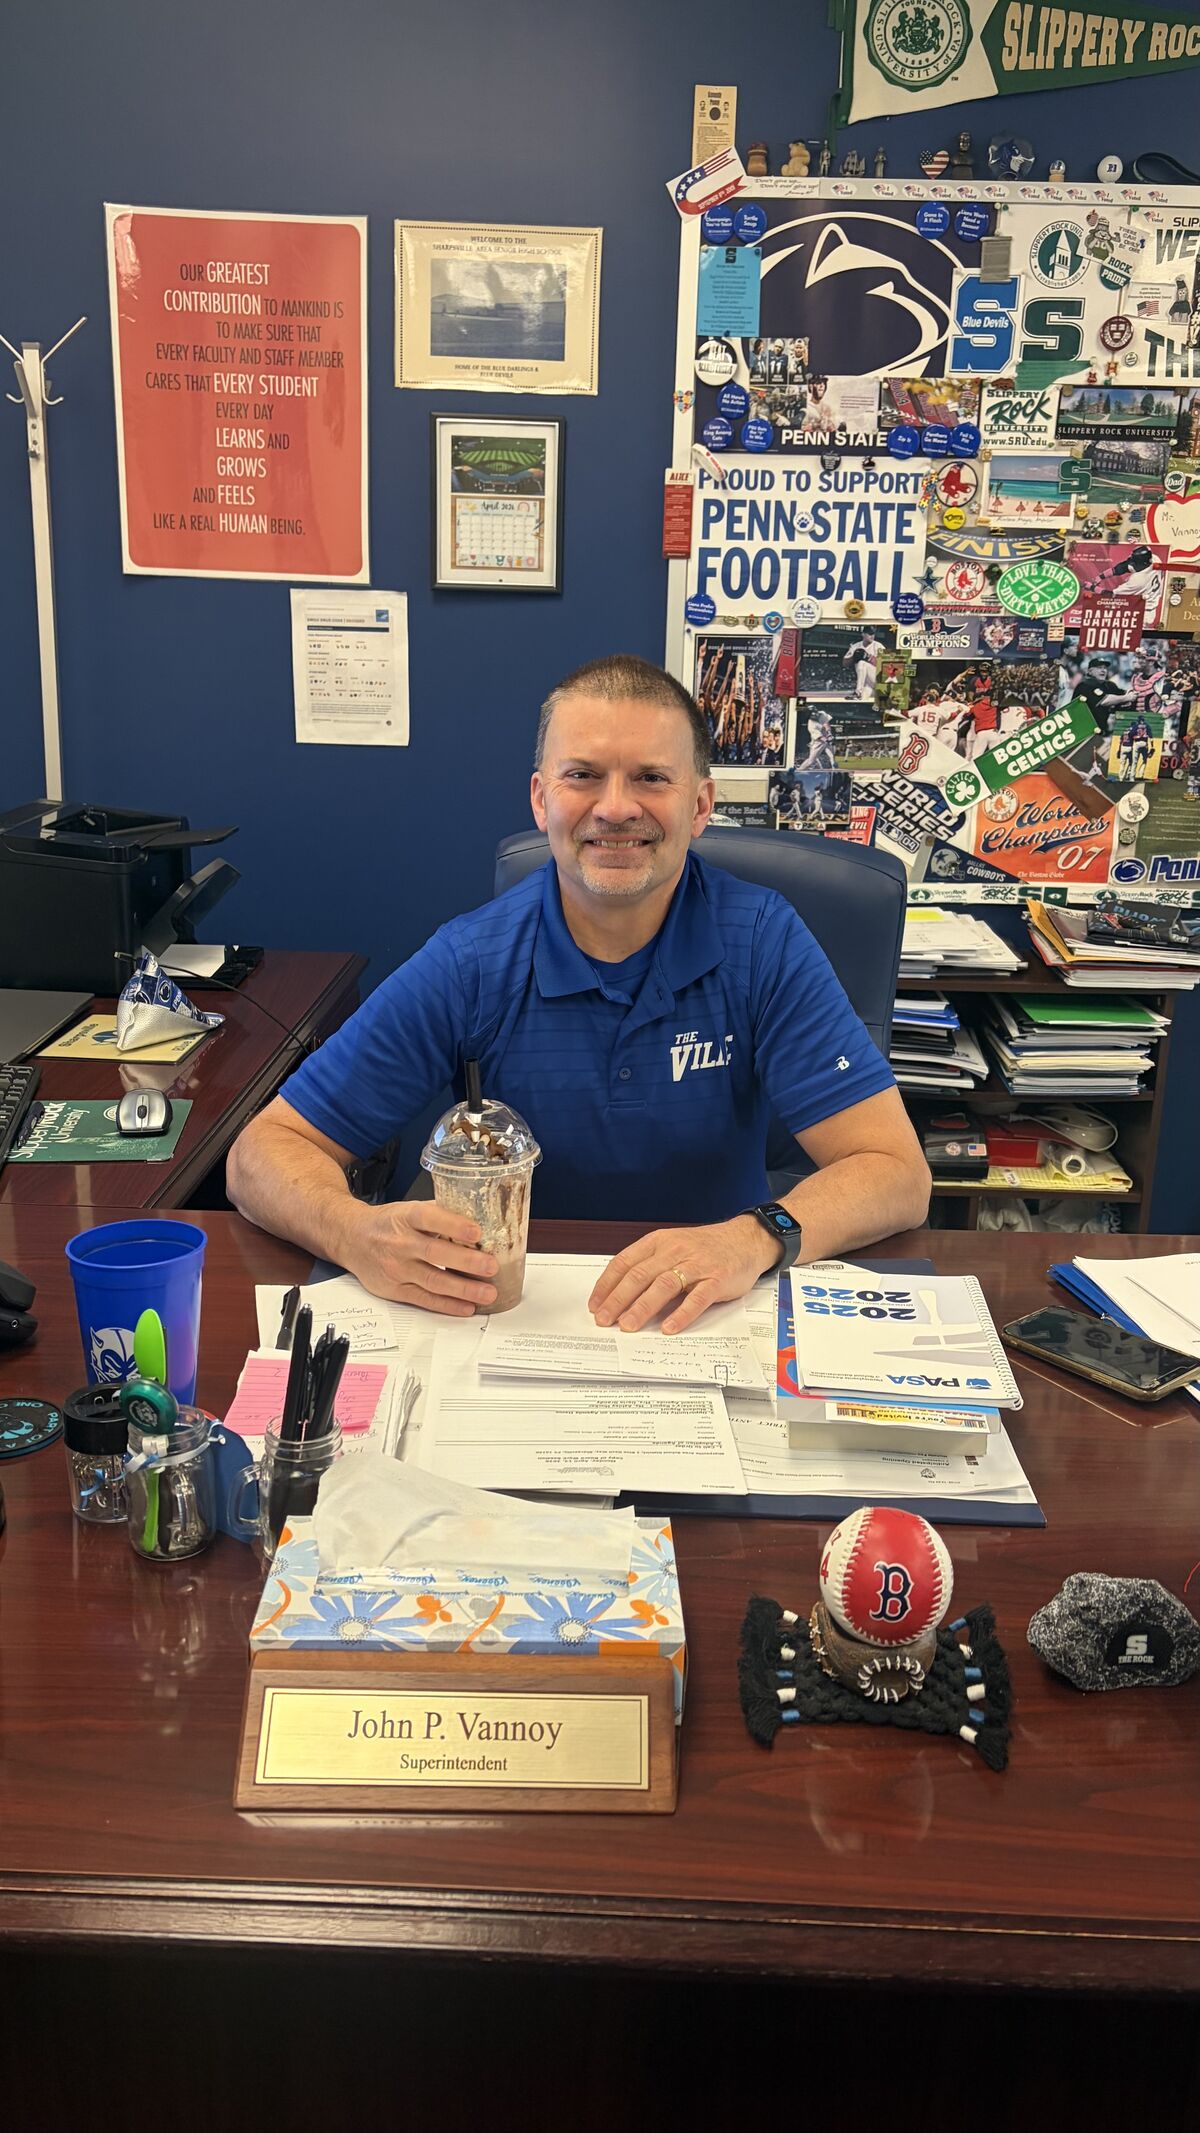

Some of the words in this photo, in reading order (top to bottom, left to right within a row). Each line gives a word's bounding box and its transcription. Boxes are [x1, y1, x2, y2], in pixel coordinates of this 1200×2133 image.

[1002, 2, 1146, 71] SLIPPERY
[875, 33, 940, 79] UNIVERSITY
[951, 39, 961, 54] PA
[1051, 222, 1069, 232] ROCK
[471, 236, 503, 244] WELCOME
[515, 237, 527, 245] THE
[180, 264, 204, 281] OUR
[206, 261, 270, 285] GREATEST
[1108, 256, 1133, 274] ROCK
[1101, 269, 1127, 287] PRIDE
[163, 289, 261, 315] CONTRIBUTION
[264, 298, 278, 315] TO
[281, 299, 330, 318] MANKIND
[333, 301, 344, 319] IS
[216, 321, 230, 339] TO
[233, 323, 263, 341] MAKE
[266, 323, 294, 342] SURE
[297, 325, 321, 343] THAT
[962, 316, 985, 329] Blue
[986, 316, 1009, 330] Devils
[156, 342, 189, 361] EVERY
[192, 345, 236, 364] FACULTY
[239, 348, 261, 365] AND
[264, 349, 295, 367] STAFF
[298, 351, 344, 369] MEMBER
[146, 371, 181, 390] CARES
[184, 374, 211, 392] THAT
[213, 372, 255, 394] EVERY
[259, 374, 319, 397] STUDENT
[987, 389, 1040, 399] SLIPPERY
[216, 401, 249, 420] EVERY
[254, 403, 274, 420] DAY
[985, 392, 1053, 425] ROCK
[216, 427, 265, 449] LEARNS
[267, 433, 290, 450] AND
[781, 429, 830, 446] PENN
[834, 431, 888, 447] STATE
[984, 424, 1048, 433] UNIVERSITY
[1057, 427, 1096, 435] SLIPPERY
[1100, 427, 1122, 435] ROCK
[1125, 428, 1176, 437] UNIVERSITY
[983, 436, 1047, 446] www.SRU.edu
[217, 455, 267, 478] GROWS
[669, 472, 690, 482] ALICE
[1059, 458, 1092, 494] S
[698, 468, 775, 491] PROUD
[783, 470, 811, 491] TO
[818, 470, 924, 494] SUPPORT
[1167, 478, 1183, 487] Dad
[193, 487, 216, 504] AND
[217, 484, 255, 506] FEELS
[481, 501, 500, 512] April
[153, 512, 175, 530] LIKE
[179, 514, 187, 530] A
[190, 514, 216, 532] REAL
[219, 512, 268, 534] HUMAN
[270, 518, 306, 536] BEING.
[702, 498, 797, 541] PENN
[809, 500, 916, 544] STATE
[929, 532, 1065, 557] FINISH
[697, 546, 904, 602] FOOTBALL
[1007, 563, 1038, 584] LOVE
[1042, 563, 1072, 585] THAT
[1001, 588, 1034, 614] DIRTY
[1034, 588, 1076, 615] WATER
[1083, 609, 1140, 628] DAMAGE
[900, 634, 971, 648] CHAMPIONS
[1085, 628, 1132, 649] DONE
[921, 711, 936, 723] 15
[992, 710, 1072, 765] BOSTON
[899, 732, 930, 775] B
[1006, 728, 1077, 778] CELTICS
[946, 771, 975, 794] CELTICS
[882, 769, 958, 828] WORLD
[716, 806, 727, 814] of
[727, 806, 743, 815] the
[869, 783, 956, 841] SERIES
[1016, 796, 1082, 829] Worl
[903, 837, 917, 850] 04
[981, 816, 1111, 854] Champions
[1056, 844, 1105, 871] '07
[967, 866, 1006, 883] COWBOYS
[675, 1031, 699, 1045] THE
[49, 1108, 90, 1144] University
[800, 1285, 913, 1303] 2026
[803, 1301, 917, 1321] 2025
[886, 1374, 960, 1389] PASA
[915, 1416, 946, 1425] You're
[869, 1561, 913, 1623] B
[1124, 1634, 1149, 1655] S
[1118, 1655, 1133, 1664] THE
[1133, 1655, 1154, 1664] ROCK
[348, 1710, 414, 1741] John
[424, 1711, 447, 1742] P.
[456, 1711, 563, 1750] Vannoy
[399, 1753, 509, 1773] Superintendent
